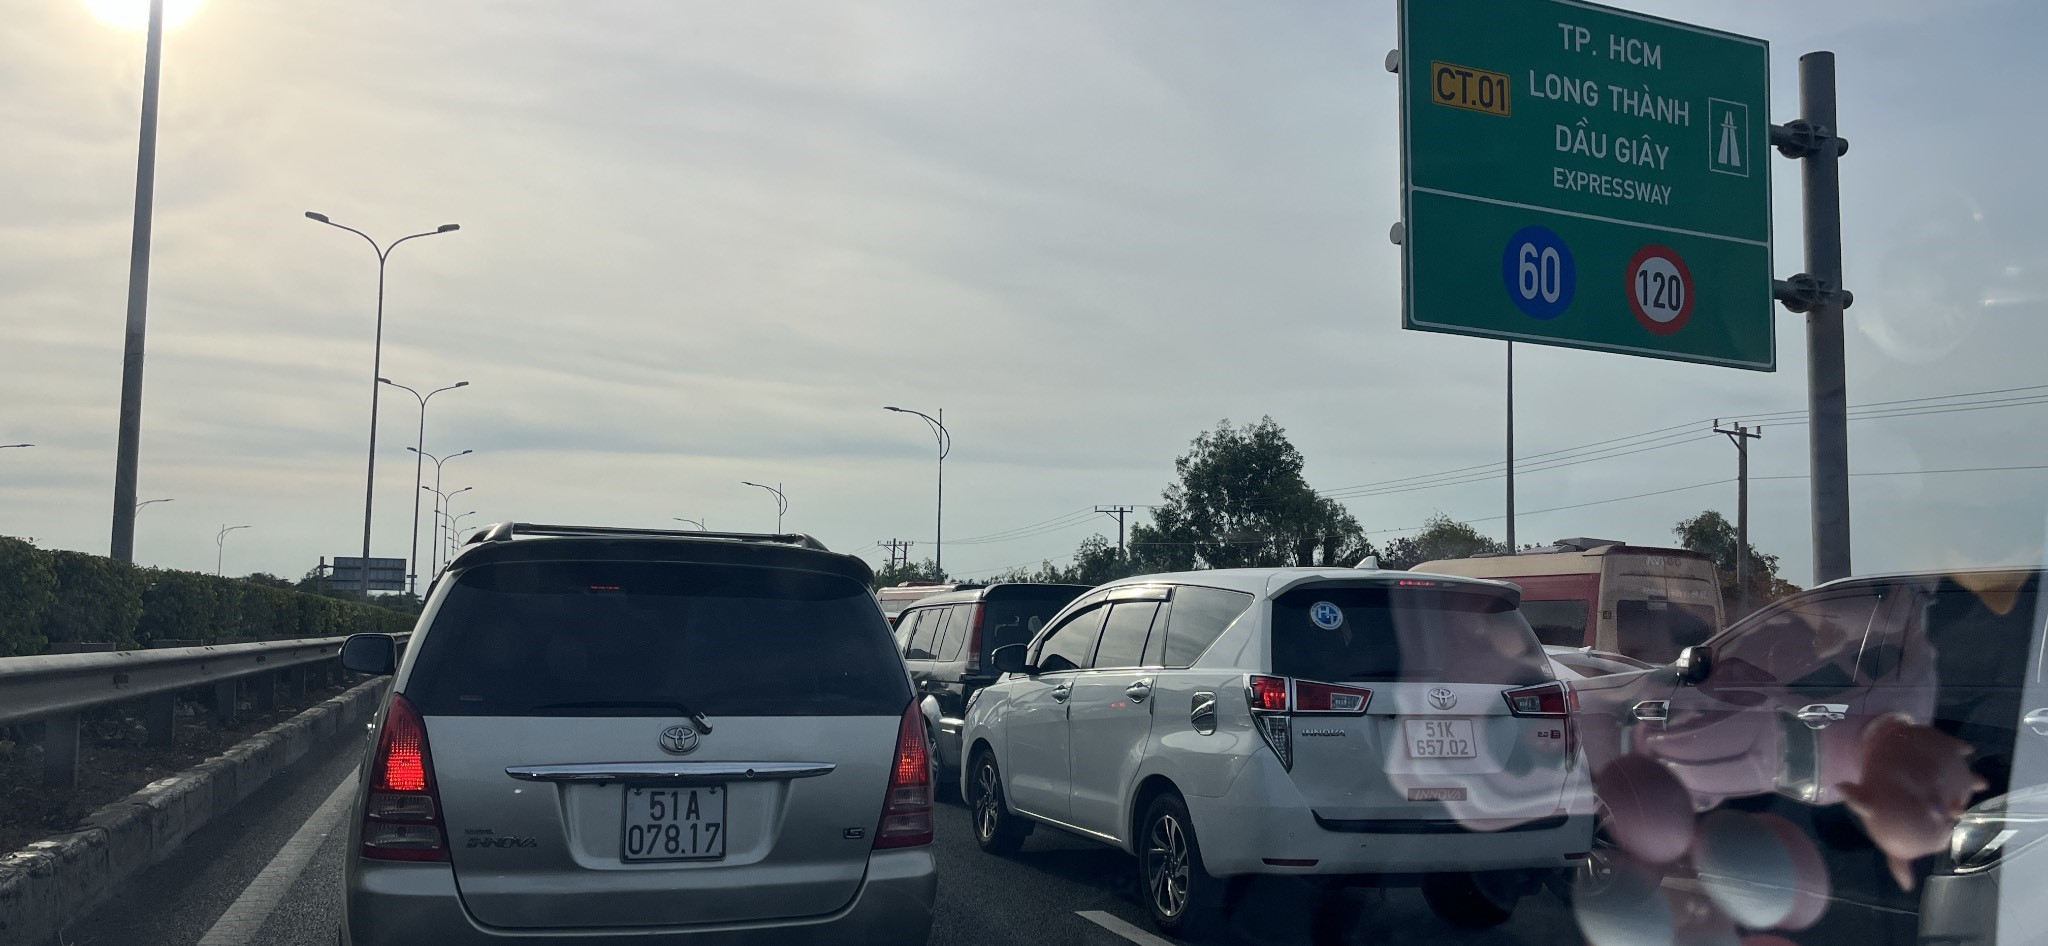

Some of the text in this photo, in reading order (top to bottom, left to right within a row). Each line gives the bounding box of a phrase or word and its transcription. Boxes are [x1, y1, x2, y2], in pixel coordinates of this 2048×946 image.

[1557, 22, 1662, 70] TP. HCM
[1436, 67, 1506, 111] CT.01
[1529, 69, 1689, 127] LONG THÀNH
[1555, 116, 1669, 170] DẦU GIÂY
[1553, 166, 1672, 206] EXPRESSWAY
[1518, 242, 1561, 304] 60
[1638, 269, 1682, 312] 120
[1301, 729, 1346, 737] INNOVA
[1416, 739, 1468, 756] 657.02
[1425, 721, 1455, 738] 51K
[649, 790, 701, 821] 51A
[1414, 788, 1461, 800] INNOVA
[628, 822, 721, 855] 078.17
